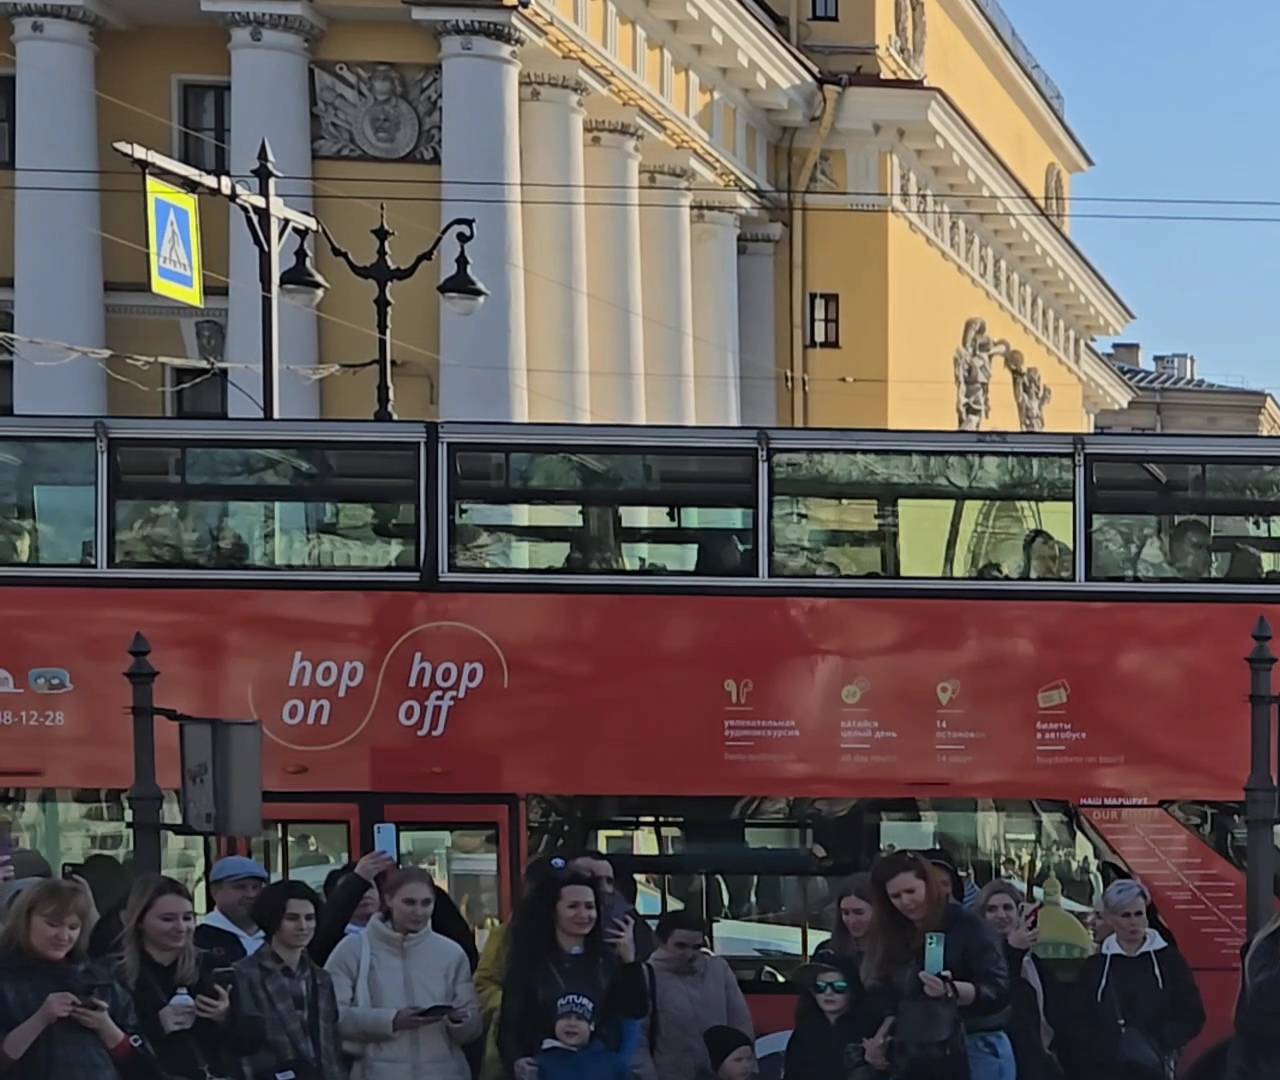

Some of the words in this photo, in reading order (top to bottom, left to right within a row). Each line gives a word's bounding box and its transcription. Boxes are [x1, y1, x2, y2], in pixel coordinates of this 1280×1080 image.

[288, 651, 365, 698] hop
[408, 652, 484, 698] hop
[0, 710, 65, 726] 8-12-28
[281, 698, 331, 726] on
[398, 690, 458, 737] off
[936, 719, 947, 729] 14
[1036, 721, 1071, 731] билеты
